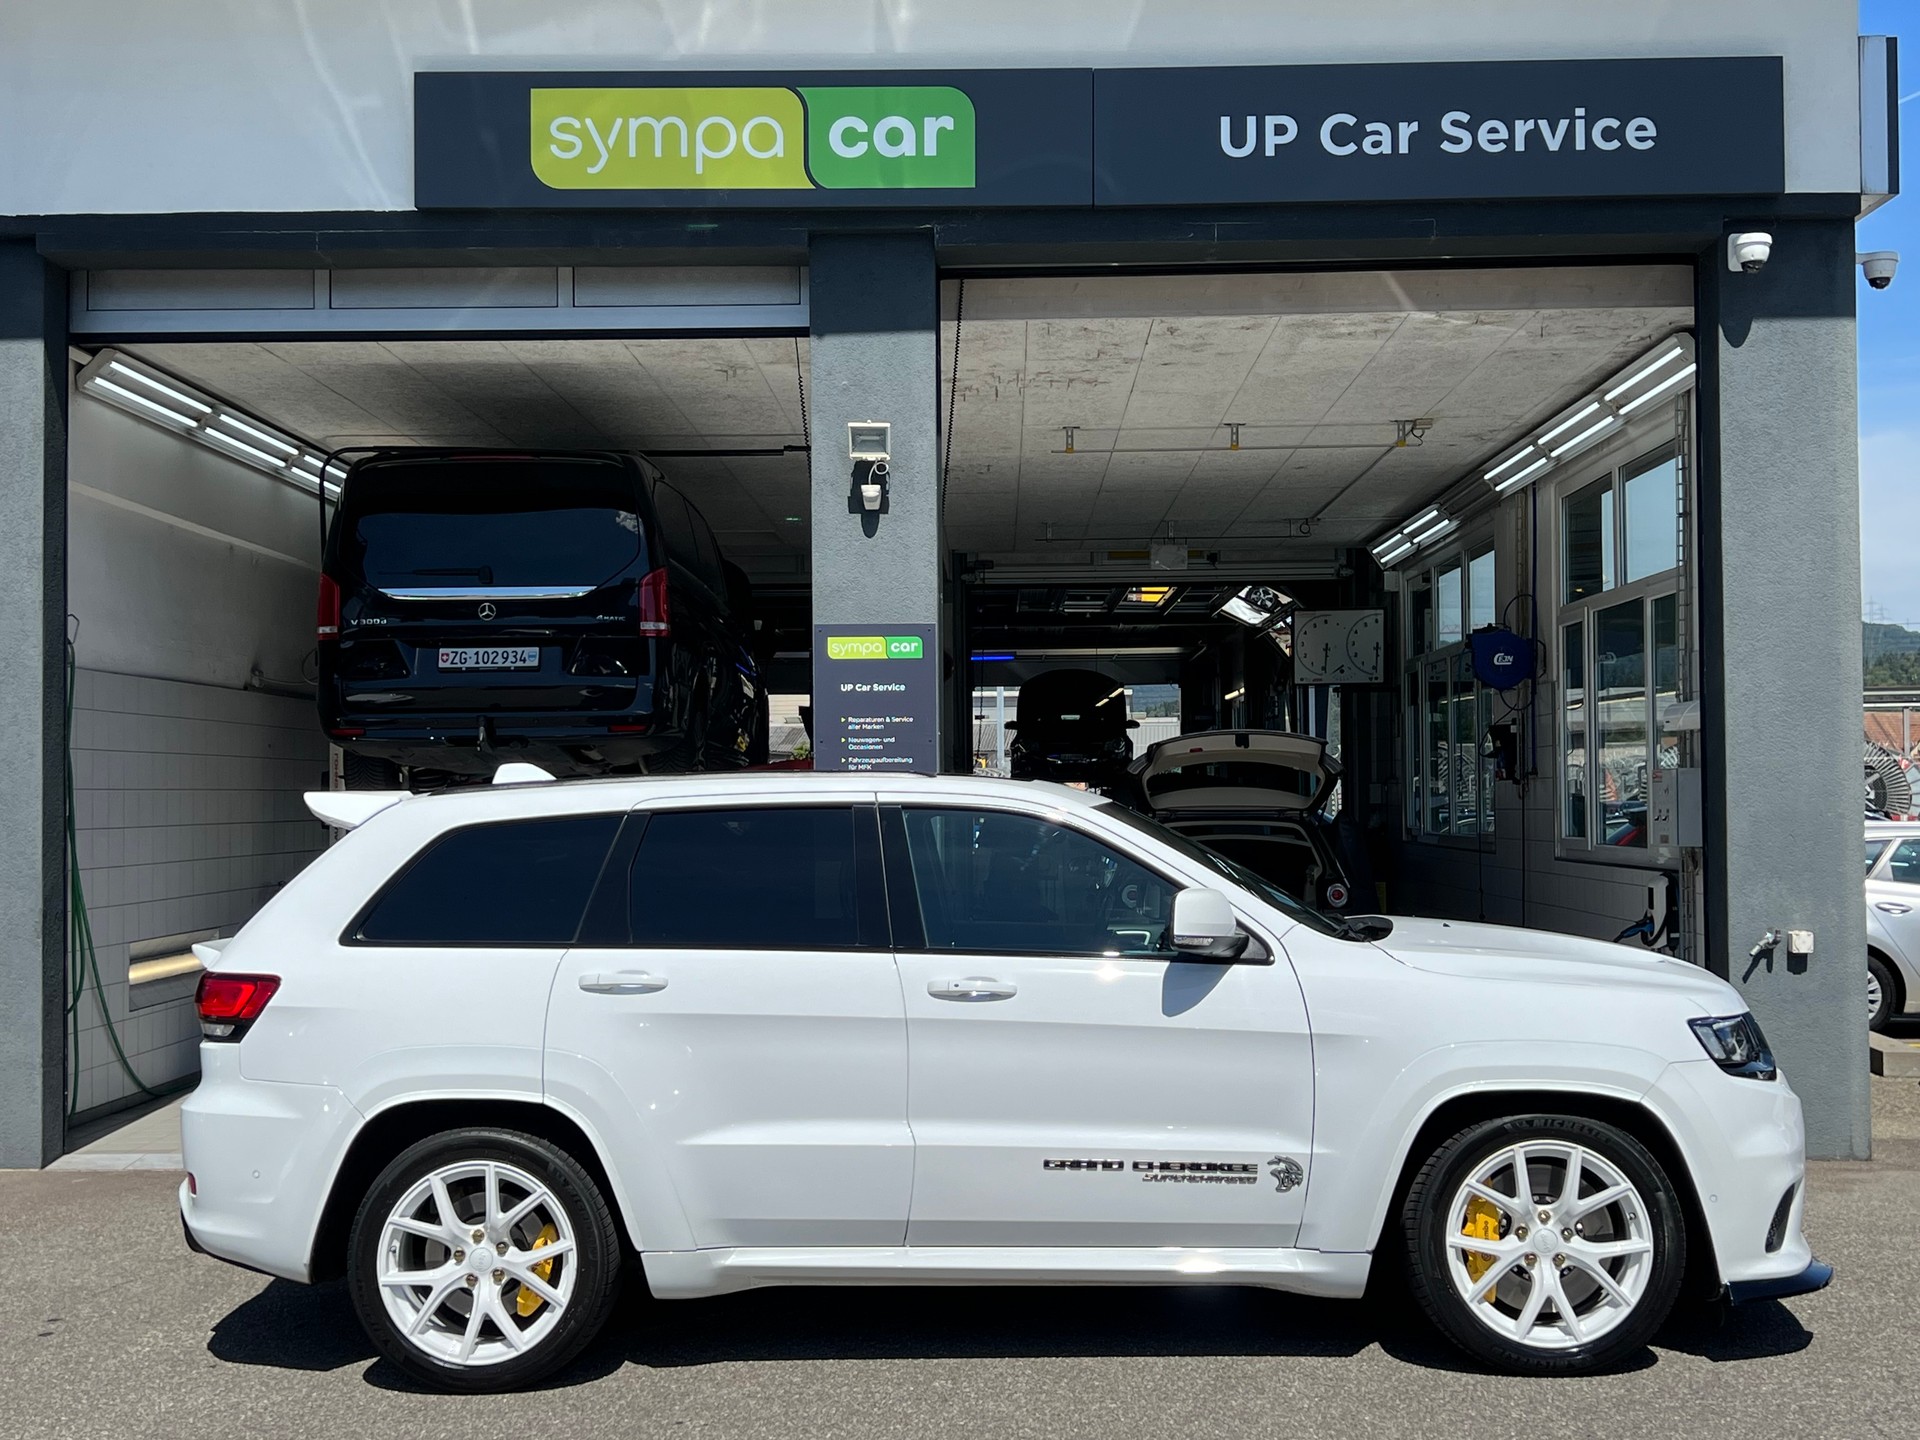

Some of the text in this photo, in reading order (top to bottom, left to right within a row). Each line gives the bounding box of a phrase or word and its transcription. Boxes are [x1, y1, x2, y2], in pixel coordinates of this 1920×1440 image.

[1220, 107, 1657, 158] UP Car Service
[549, 115, 955, 175] sympa car
[831, 642, 918, 656] sympa car
[840, 682, 906, 692] UP Car Service
[1043, 1159, 1258, 1174] GRAND CHEROKEE
